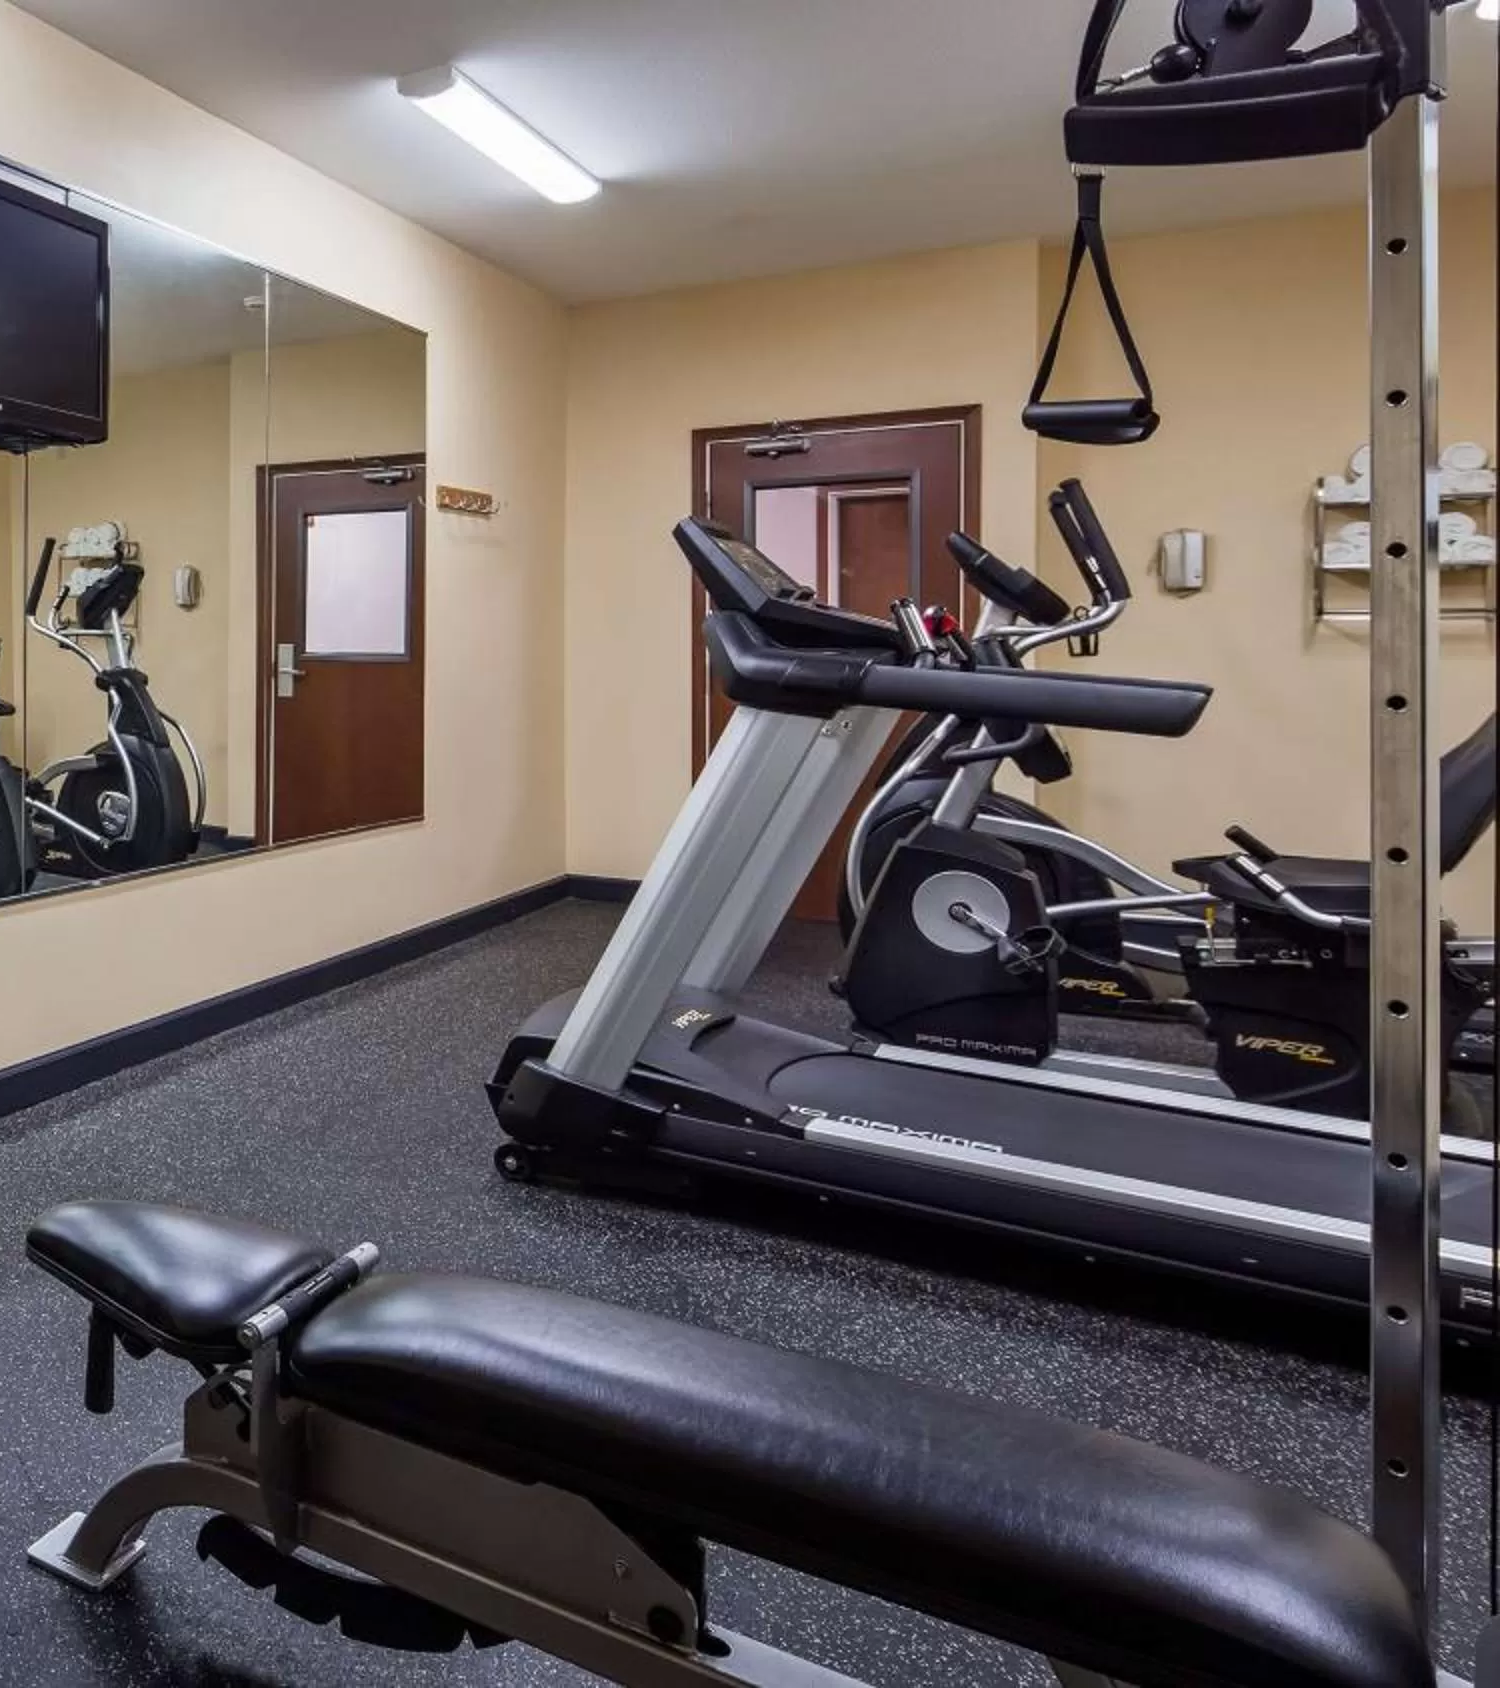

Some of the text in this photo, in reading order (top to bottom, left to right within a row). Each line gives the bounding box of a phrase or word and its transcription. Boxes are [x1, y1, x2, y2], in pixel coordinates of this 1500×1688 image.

[916, 1033, 1037, 1057] PRO MAXIMA
[1236, 1034, 1325, 1058] VIPER
